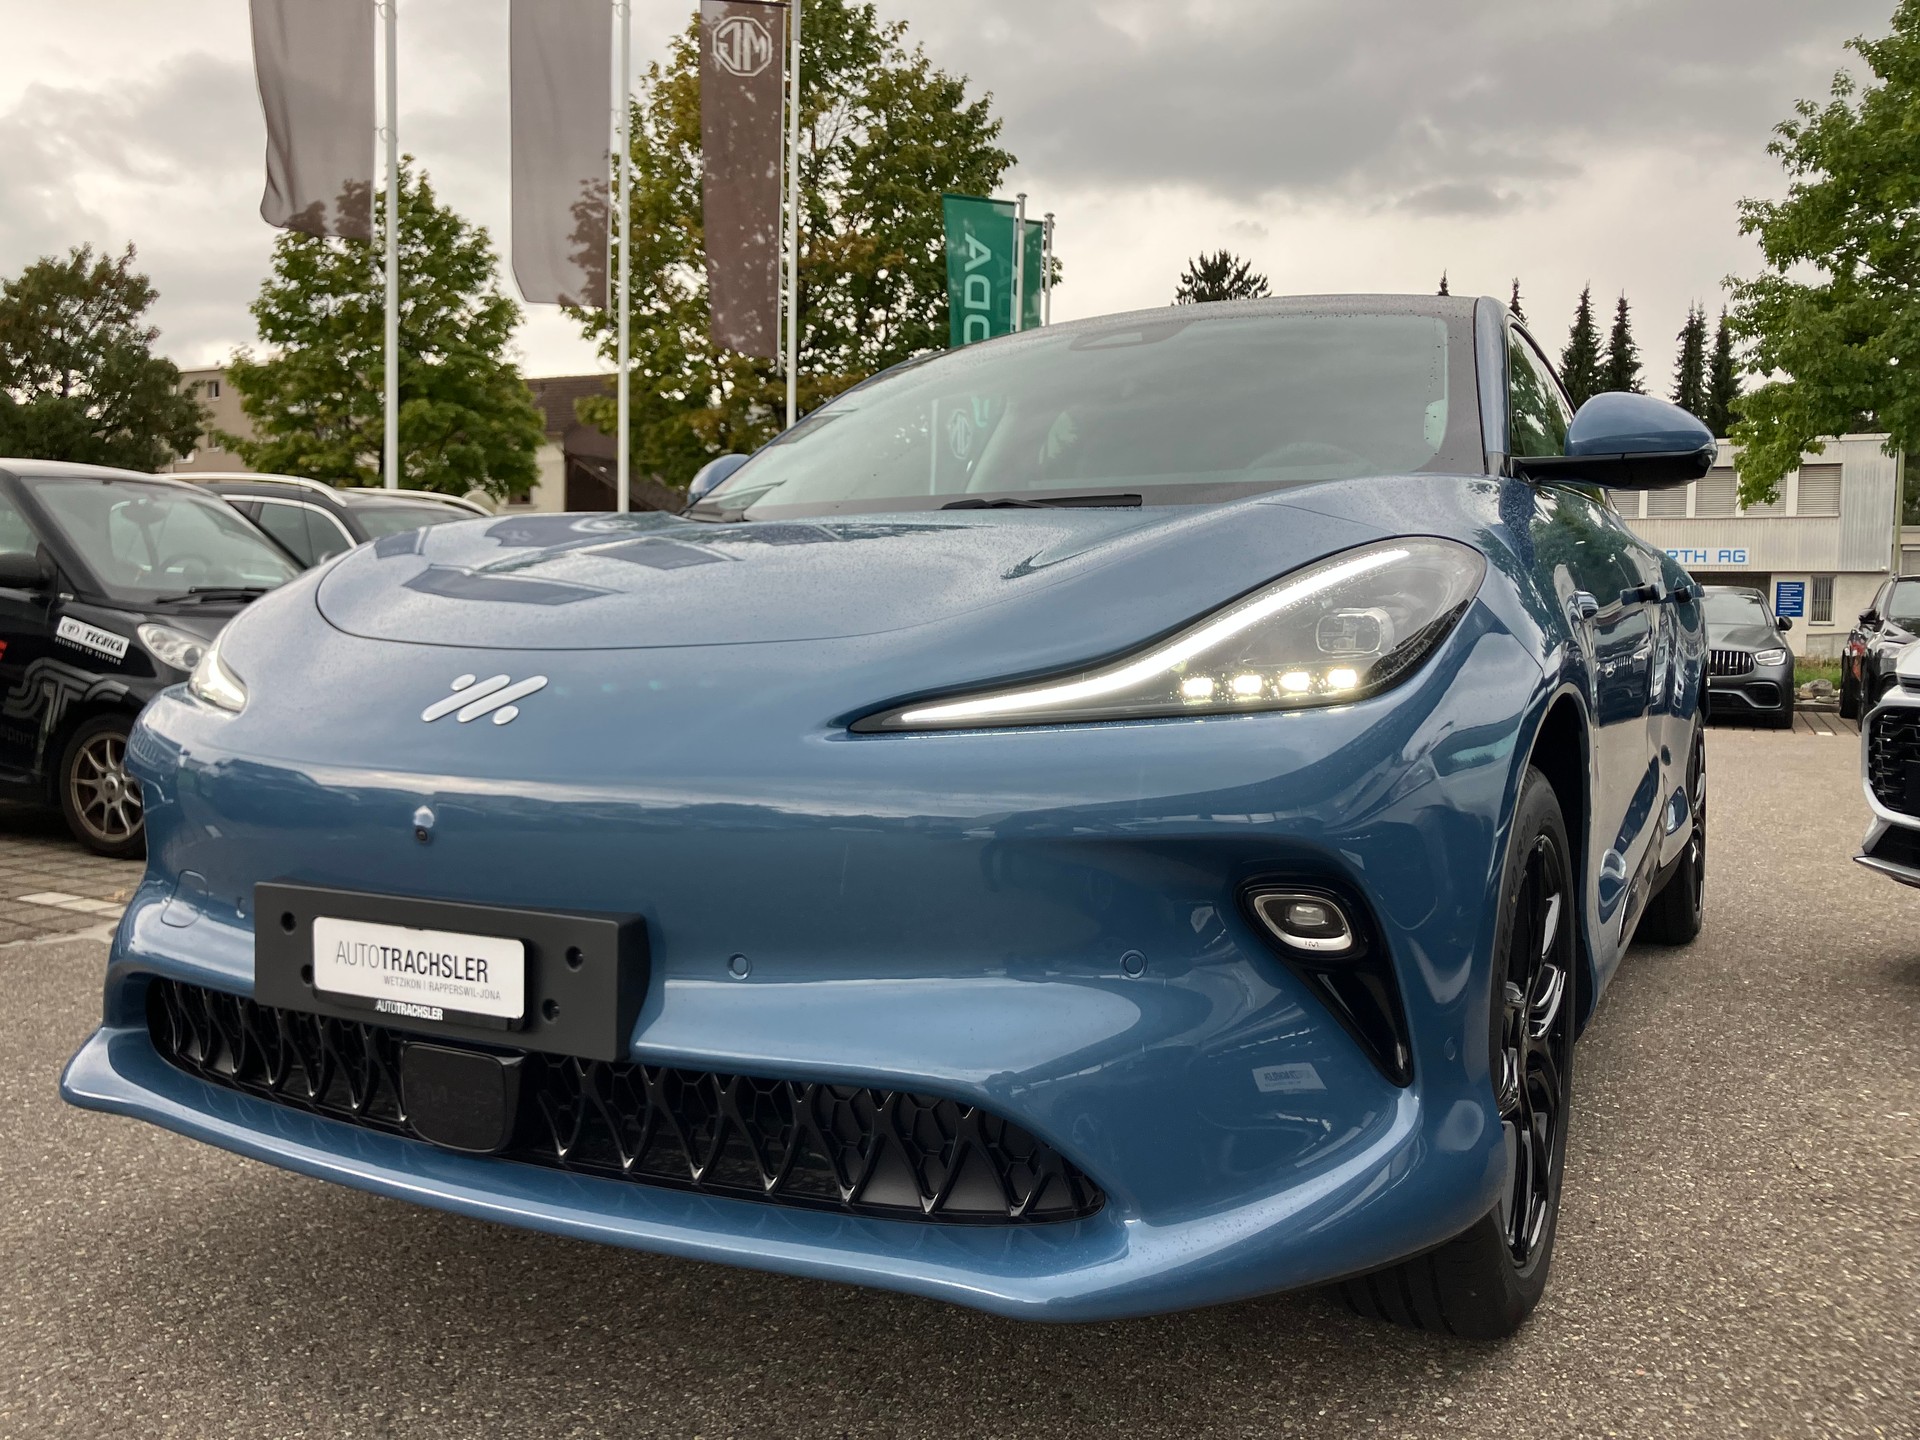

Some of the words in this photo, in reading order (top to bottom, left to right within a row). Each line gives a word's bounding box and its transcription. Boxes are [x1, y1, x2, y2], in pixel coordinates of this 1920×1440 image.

[1718, 549, 1746, 563] AG
[85, 631, 124, 653] TECNICA
[335, 940, 489, 984] AUTOTRACHSLER
[383, 975, 422, 989] WETZIKON
[429, 982, 502, 1001] RAPPERSWIL-JONA
[375, 999, 444, 1021] AUTOTRACHSLER
